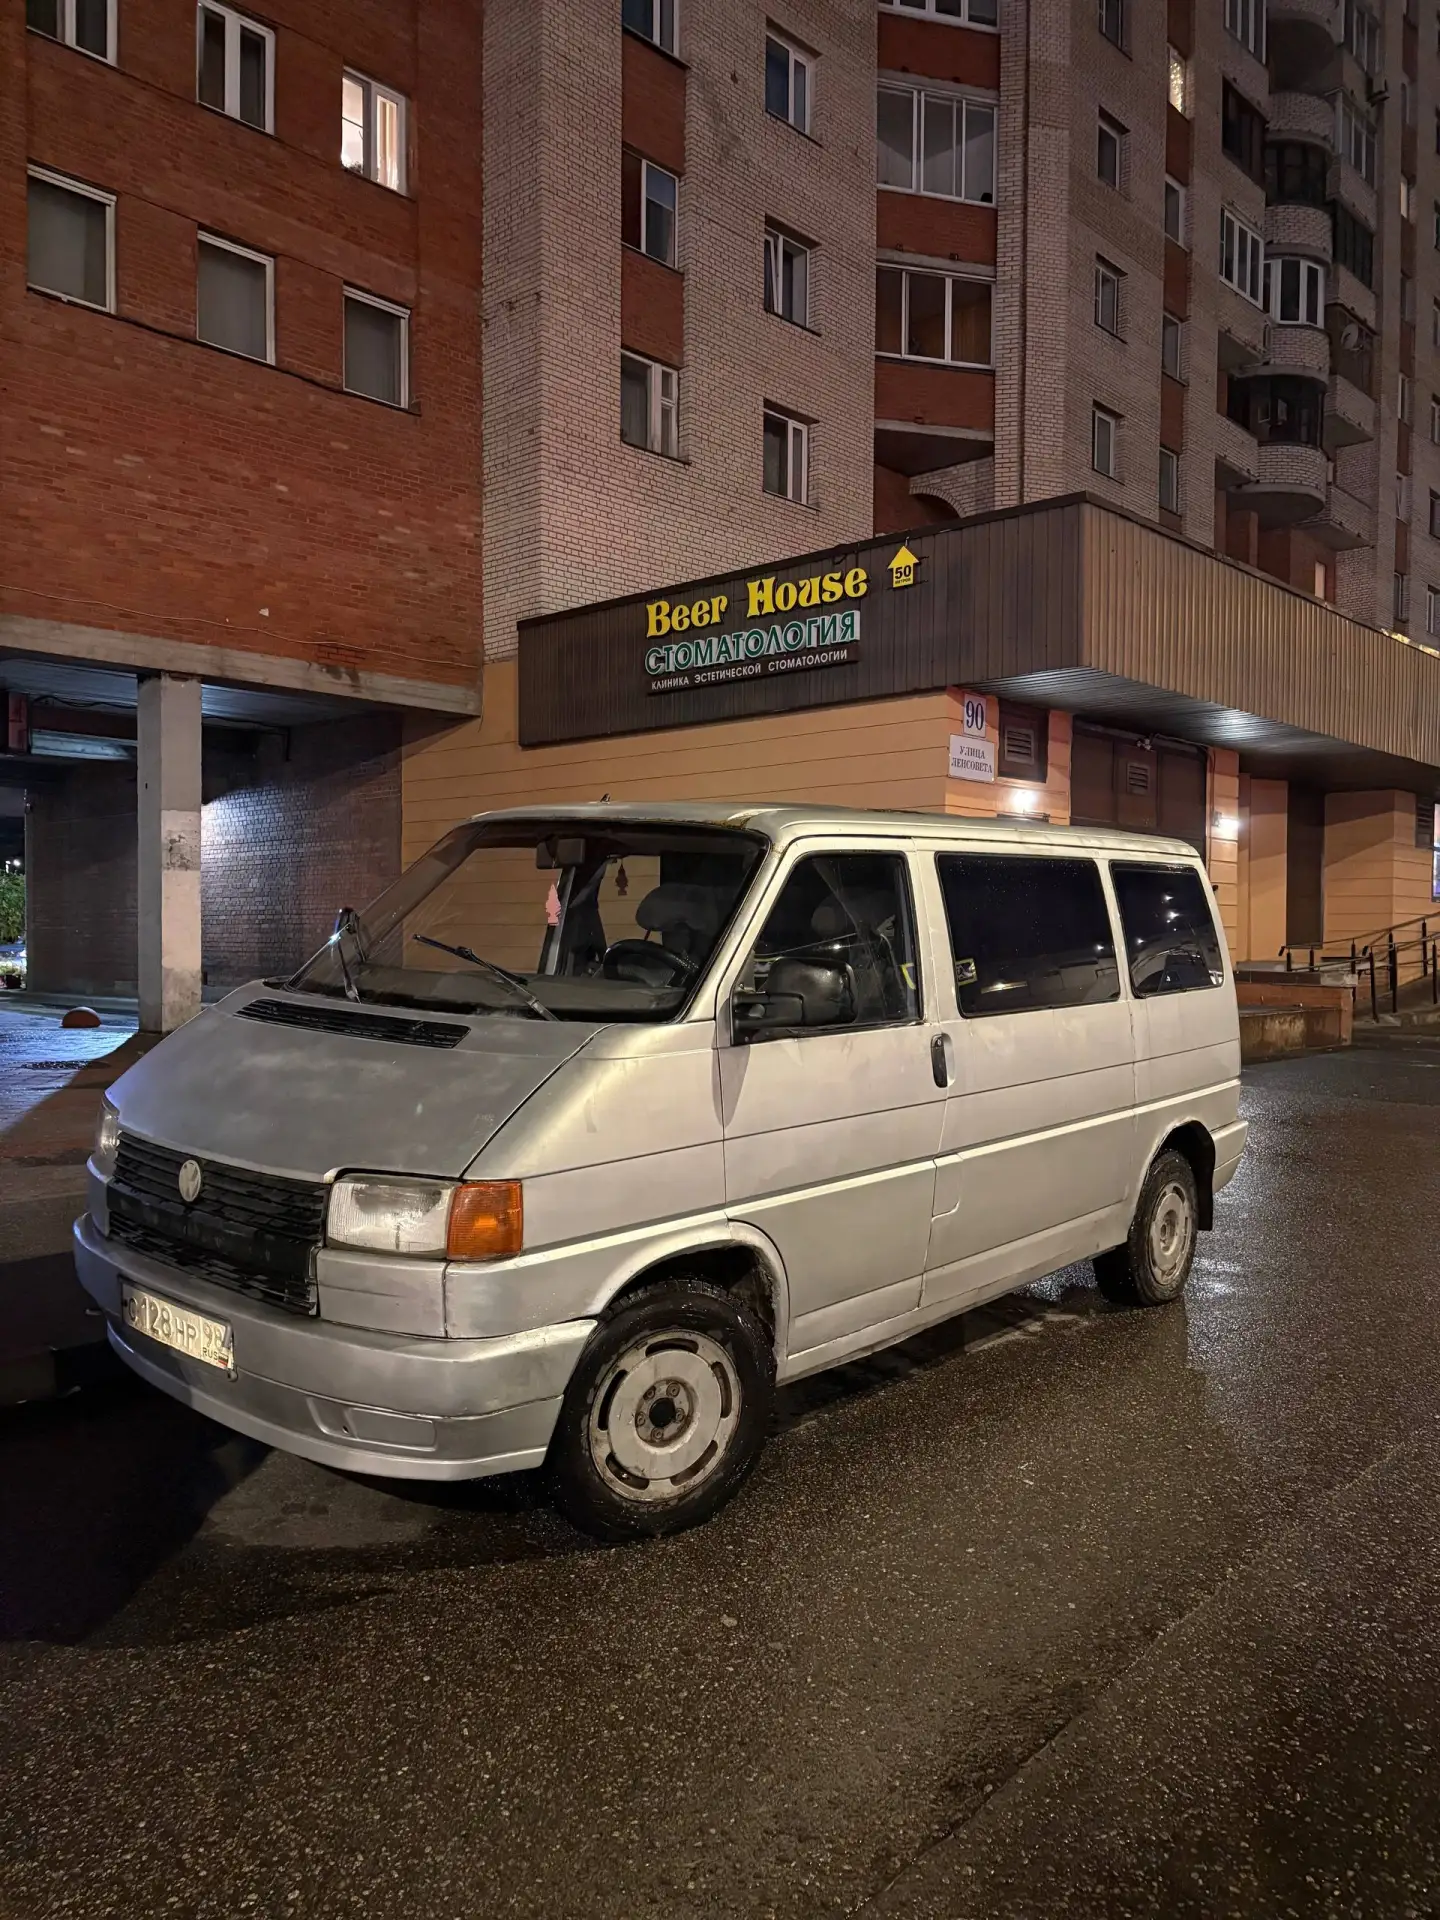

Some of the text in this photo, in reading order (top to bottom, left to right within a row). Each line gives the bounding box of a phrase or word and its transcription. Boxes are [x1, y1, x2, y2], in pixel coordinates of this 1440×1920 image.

[894, 564, 912, 580] 50
[646, 567, 868, 638] Beer House
[645, 609, 861, 675] СТОМАТОЛОГИЯ
[651, 649, 848, 690] КЛИНИКА ЭСТЕТИЧЕСКОЙ СТОМАТОЛОГИИ
[966, 701, 984, 730] 90
[951, 757, 993, 774] ЛЕНСОВЕТА
[959, 745, 986, 759] УЛИЦА
